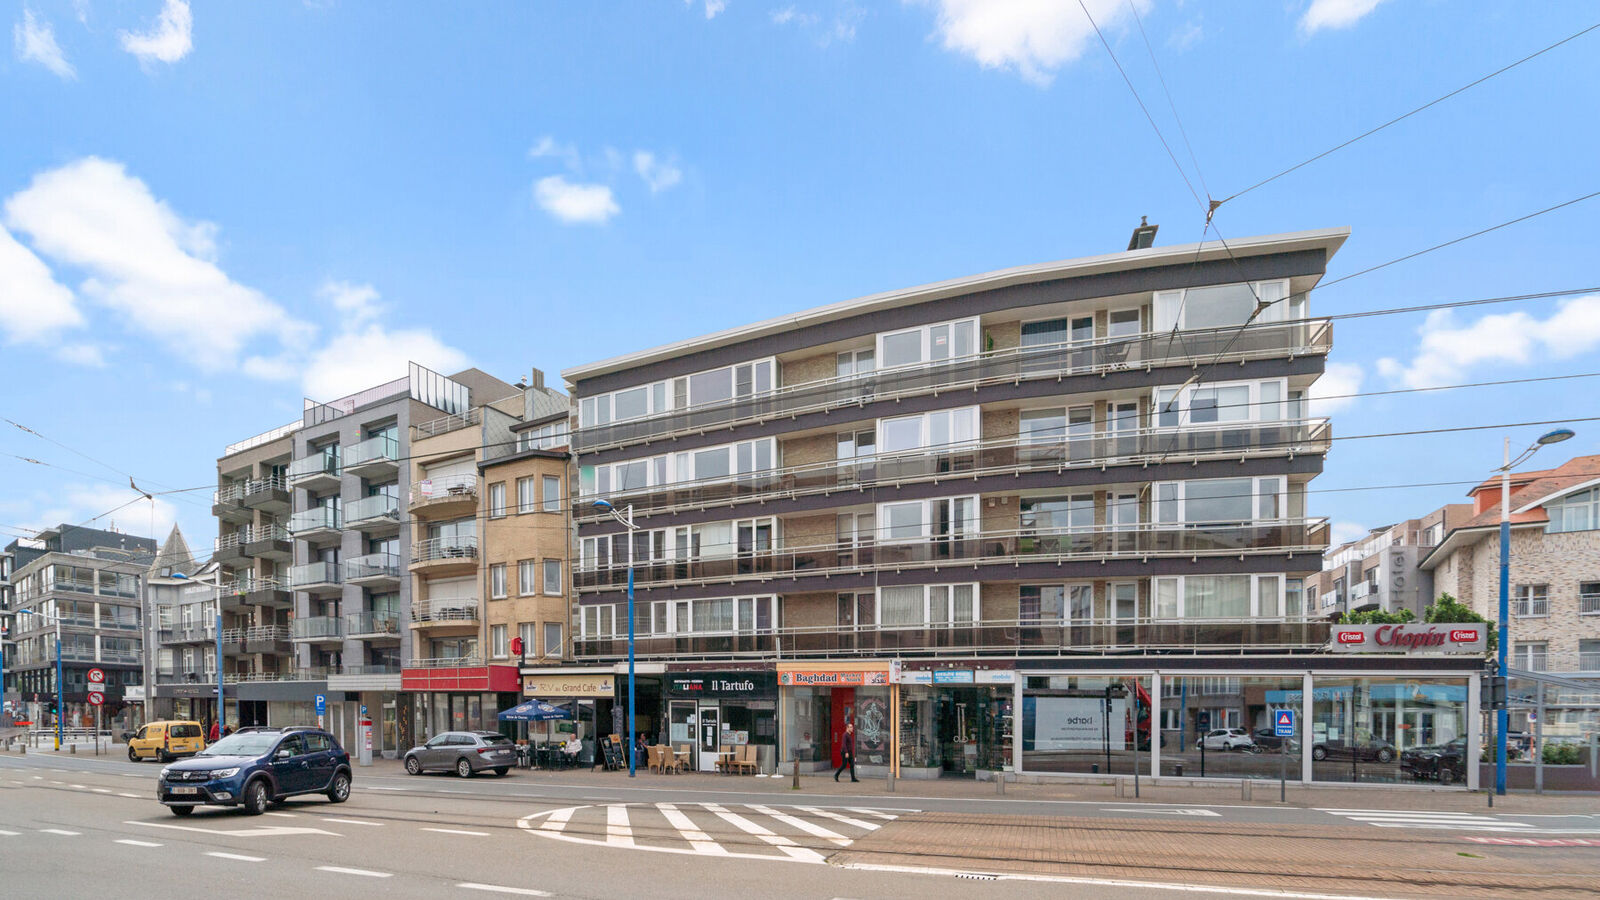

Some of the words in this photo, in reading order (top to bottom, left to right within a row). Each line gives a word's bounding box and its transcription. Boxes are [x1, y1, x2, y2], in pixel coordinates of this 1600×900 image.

[1340, 632, 1362, 641] Cristal
[1375, 625, 1447, 649] Chopin
[1453, 630, 1476, 639] Cristal
[795, 673, 838, 684] Baghdad
[562, 683, 581, 692] Grand
[712, 680, 718, 691] Il
[720, 680, 754, 691] Tartufo
[317, 696, 324, 706] P
